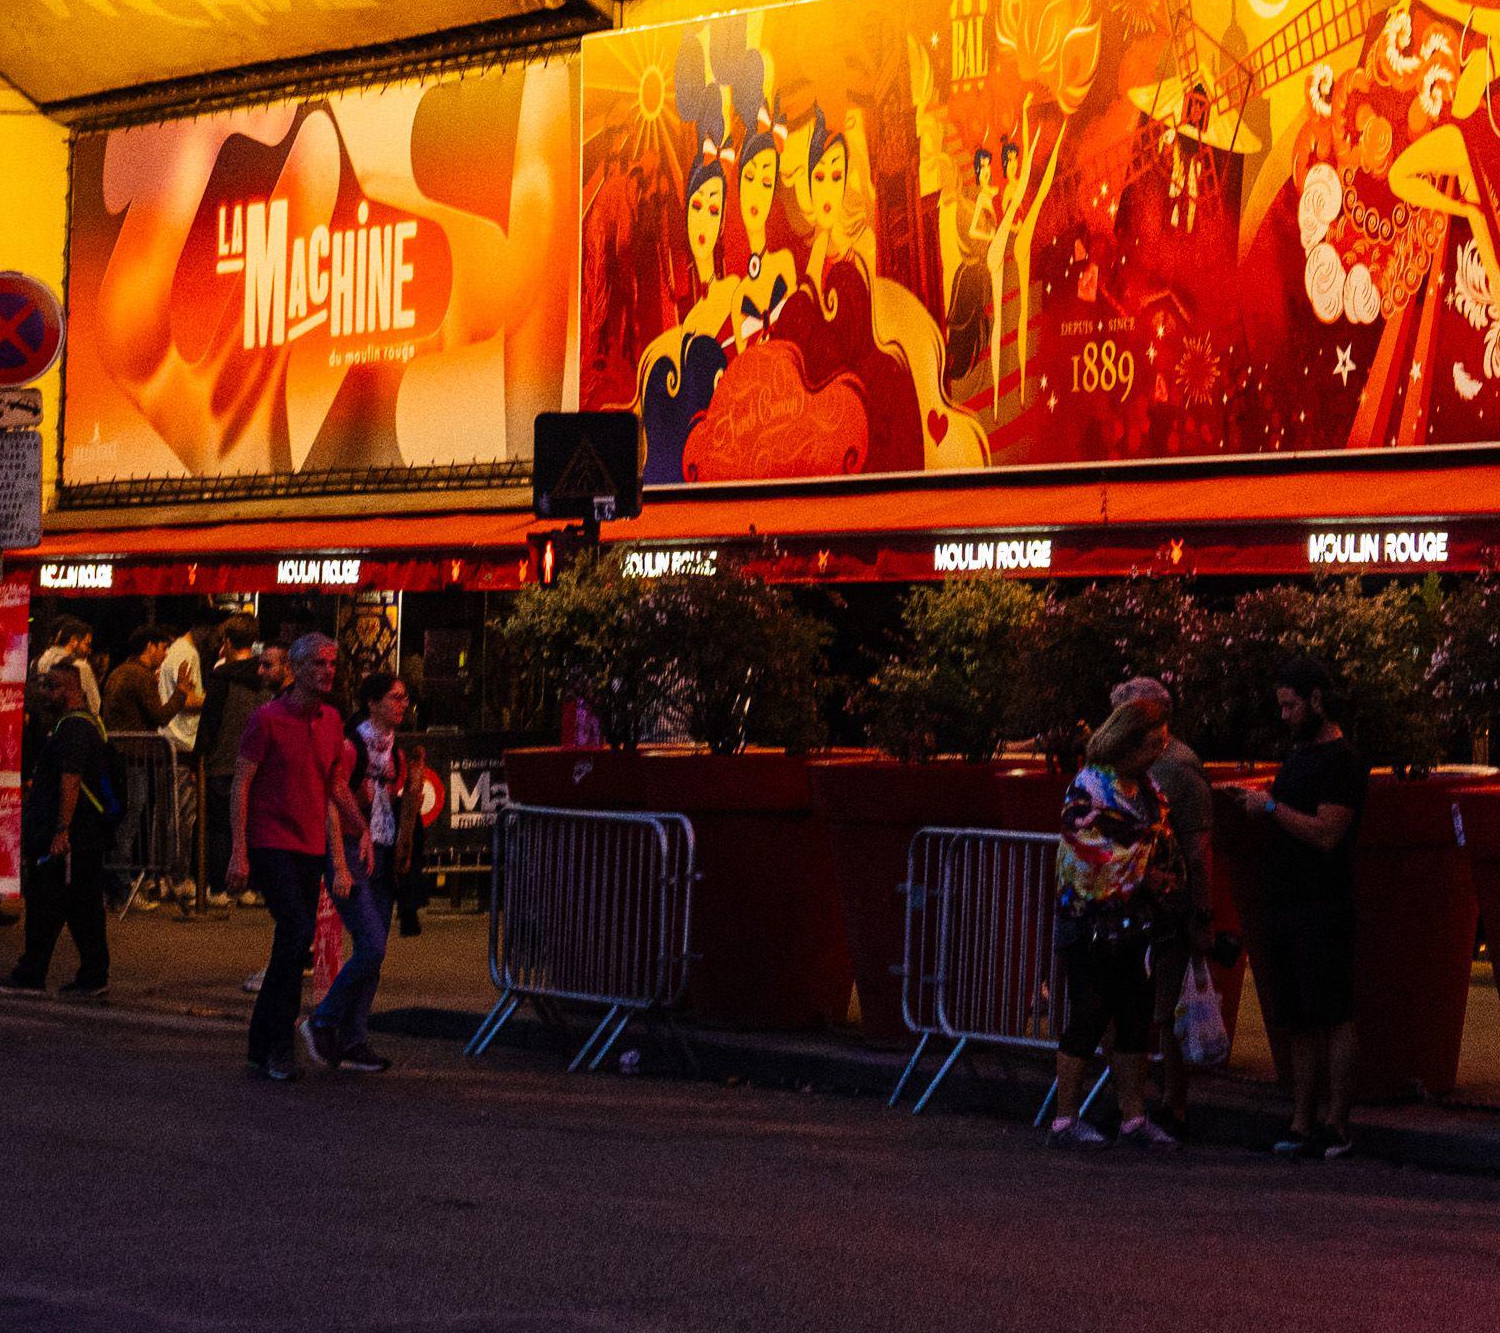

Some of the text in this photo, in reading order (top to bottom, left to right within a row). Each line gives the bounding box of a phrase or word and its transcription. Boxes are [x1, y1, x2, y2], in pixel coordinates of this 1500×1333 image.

[951, 15, 988, 80] BAL
[218, 204, 244, 256] LA
[1070, 339, 1135, 403] 1889
[933, 539, 1052, 572] MOULIN ROUGE
[1308, 531, 1449, 565] MOULIN ROUGE
[277, 558, 361, 587] MOULIN ROUGE
